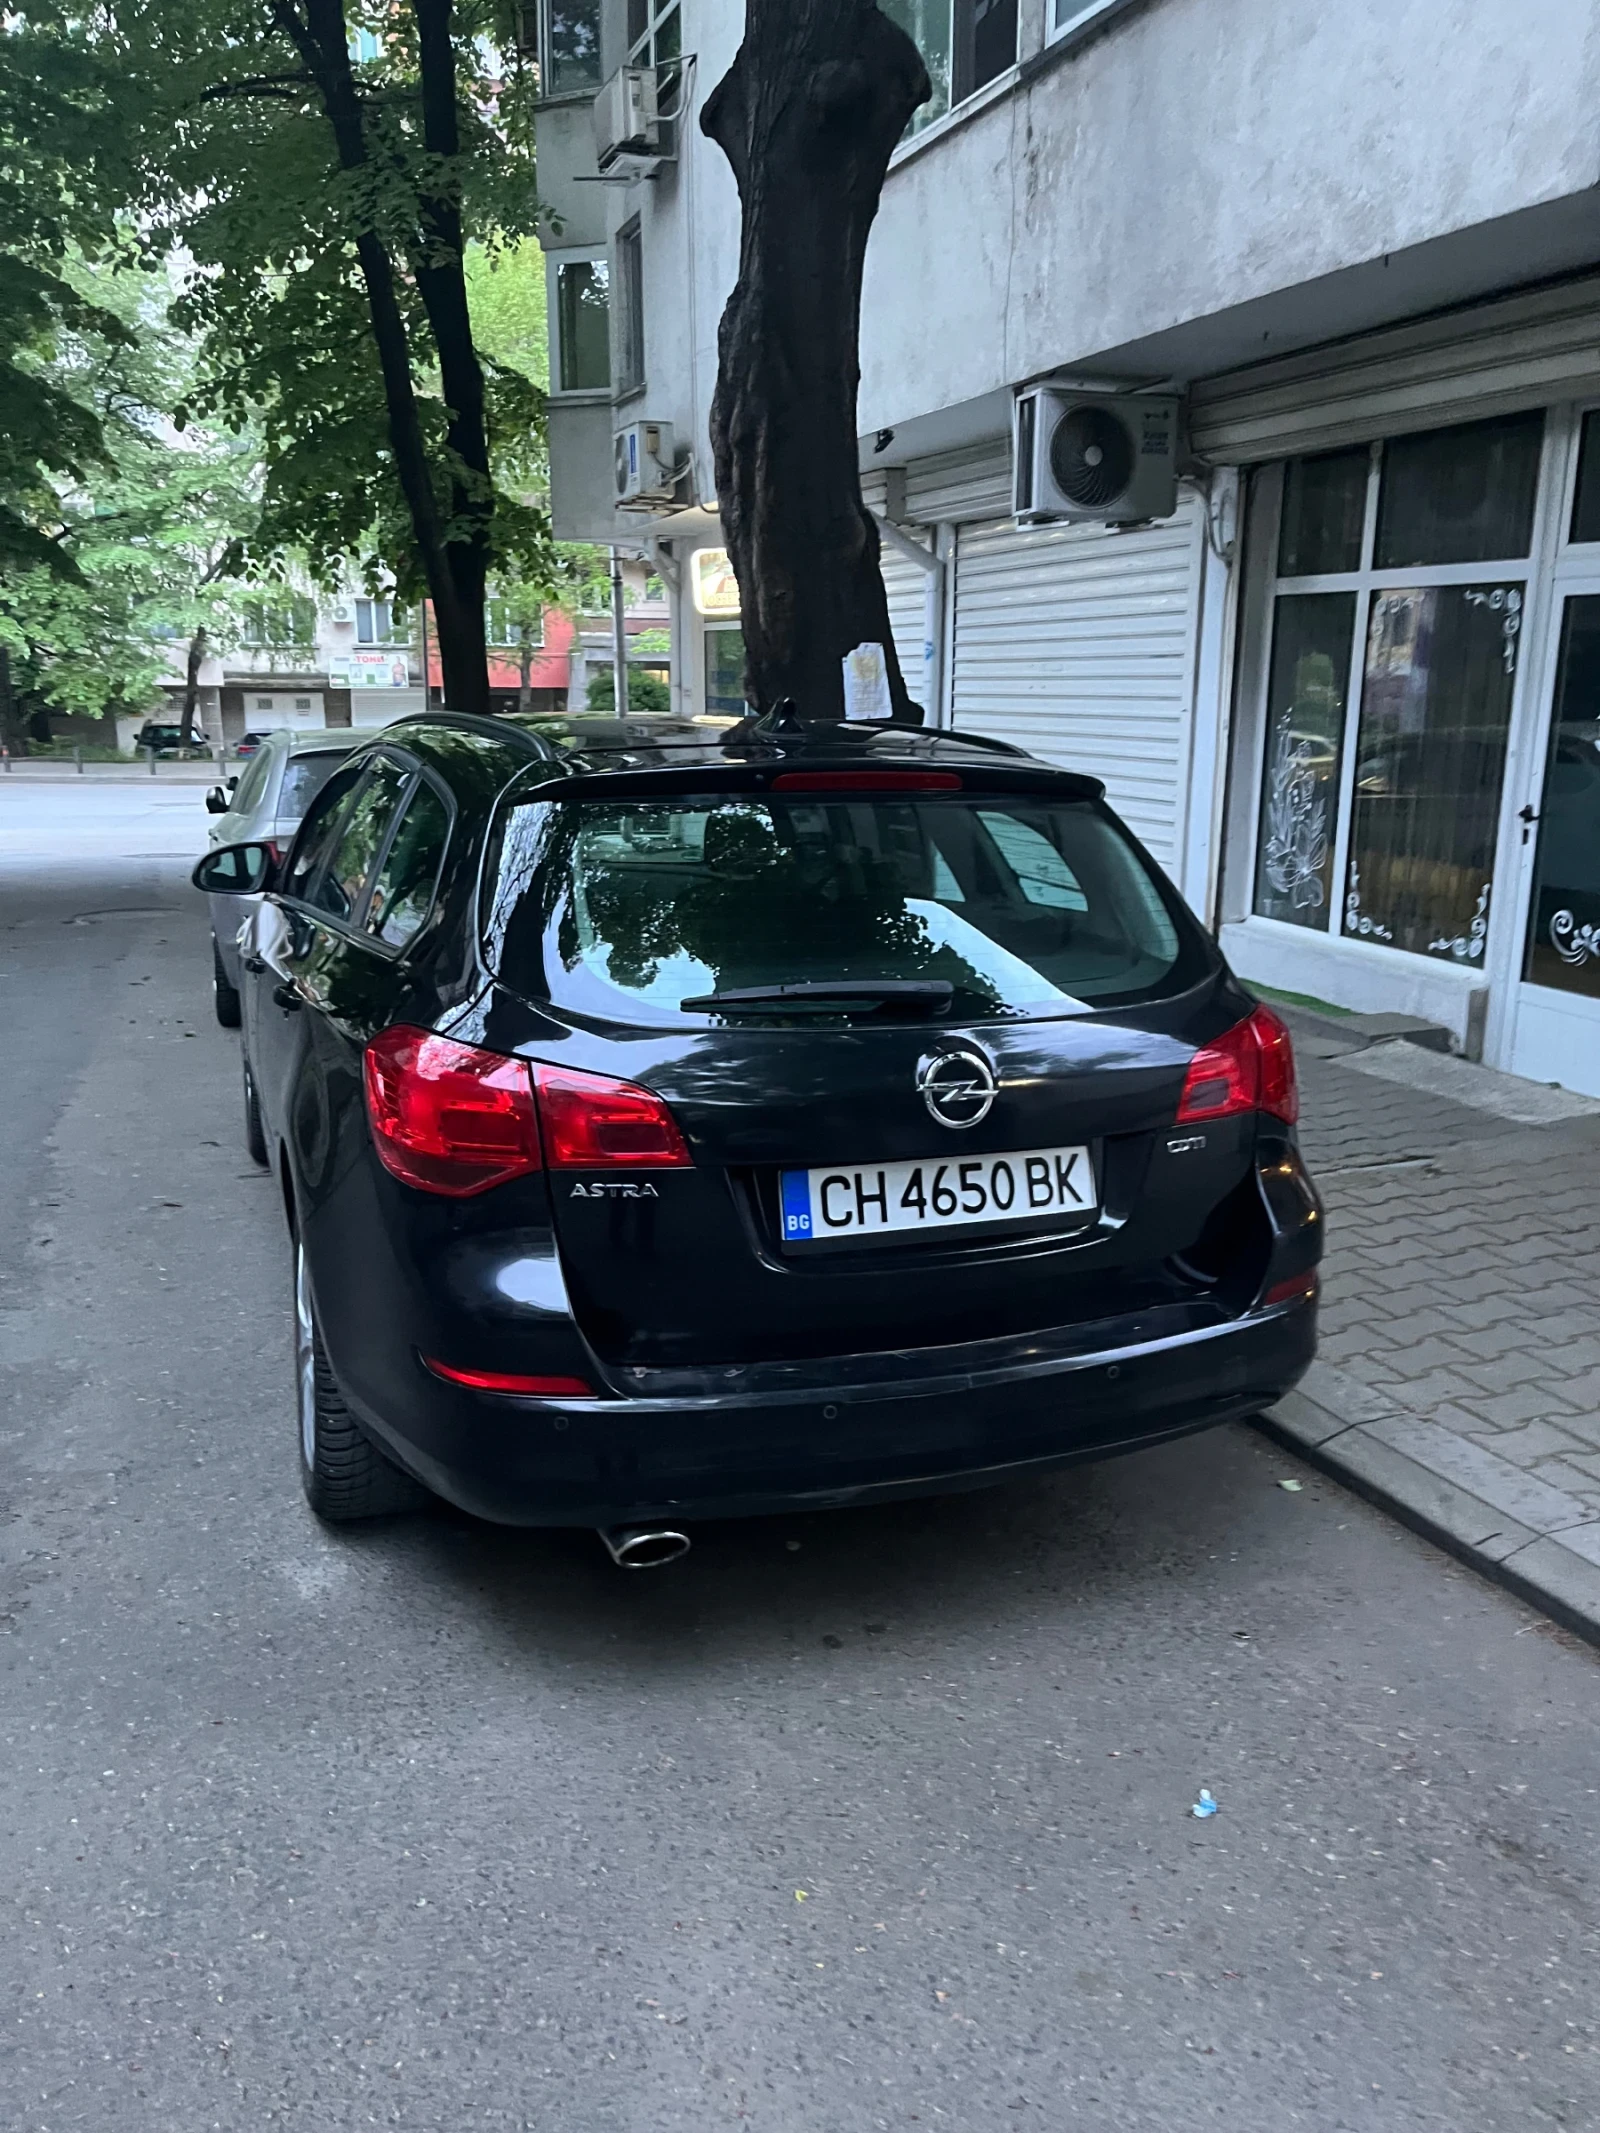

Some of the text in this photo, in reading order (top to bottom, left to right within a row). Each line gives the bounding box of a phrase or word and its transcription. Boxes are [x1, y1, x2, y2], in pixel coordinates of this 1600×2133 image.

[569, 1183, 660, 1198] ASTRA
[820, 1153, 1083, 1227] CH 4650 BK
[787, 1214, 810, 1231] BG
